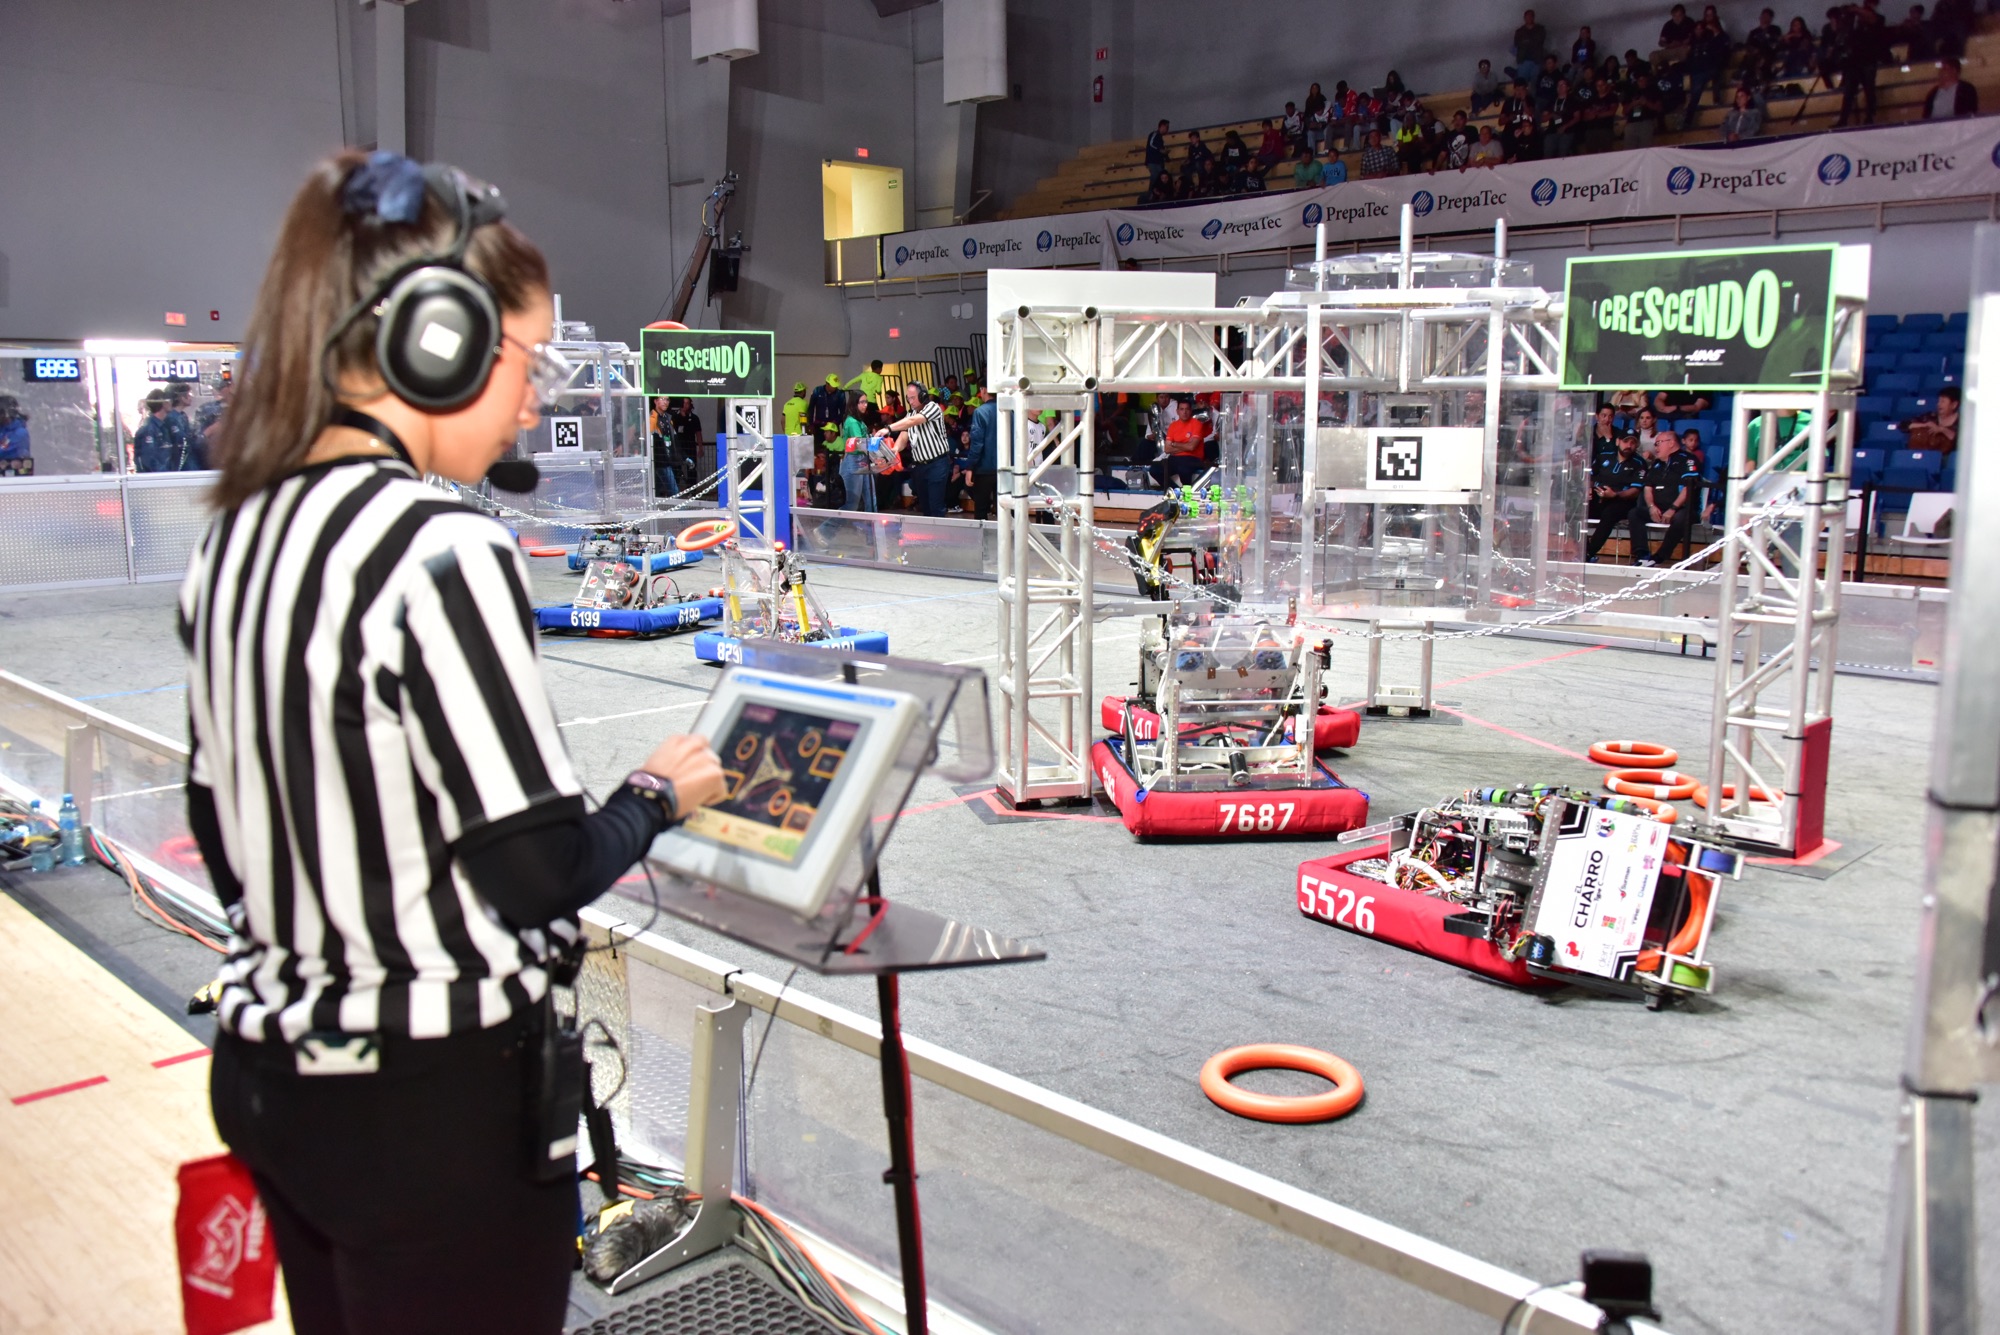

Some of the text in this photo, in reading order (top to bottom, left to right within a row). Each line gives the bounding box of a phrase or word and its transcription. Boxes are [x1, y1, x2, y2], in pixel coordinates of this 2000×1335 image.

[1856, 153, 1956, 181] PrepaTec
[1560, 177, 1639, 202] PrepaTec
[1698, 168, 1787, 194] PrepaTec
[1437, 190, 1507, 213] PrepaTec
[1326, 202, 1389, 223] PrepaTec
[1136, 227, 1184, 244] PrepaTec
[1222, 216, 1282, 237] PrepaTec
[979, 239, 1022, 256] PrepaTec
[1054, 231, 1100, 250] PrepaTec
[909, 246, 949, 262] PrepaTec
[1598, 269, 1781, 349] CRESCENDO
[35, 359, 79, 378] 6896
[149, 360, 198, 378] 00:00
[661, 341, 750, 378] CRESCENDO
[570, 611, 600, 627] 6199
[678, 607, 700, 625] 6199
[717, 641, 743, 665] 8291
[1118, 709, 1153, 740] 740
[1219, 803, 1295, 832] 7687
[1574, 850, 1603, 928] CHARRO
[1575, 884, 1583, 894] EL
[1593, 888, 1602, 901] Type
[1300, 874, 1375, 934] 5526
